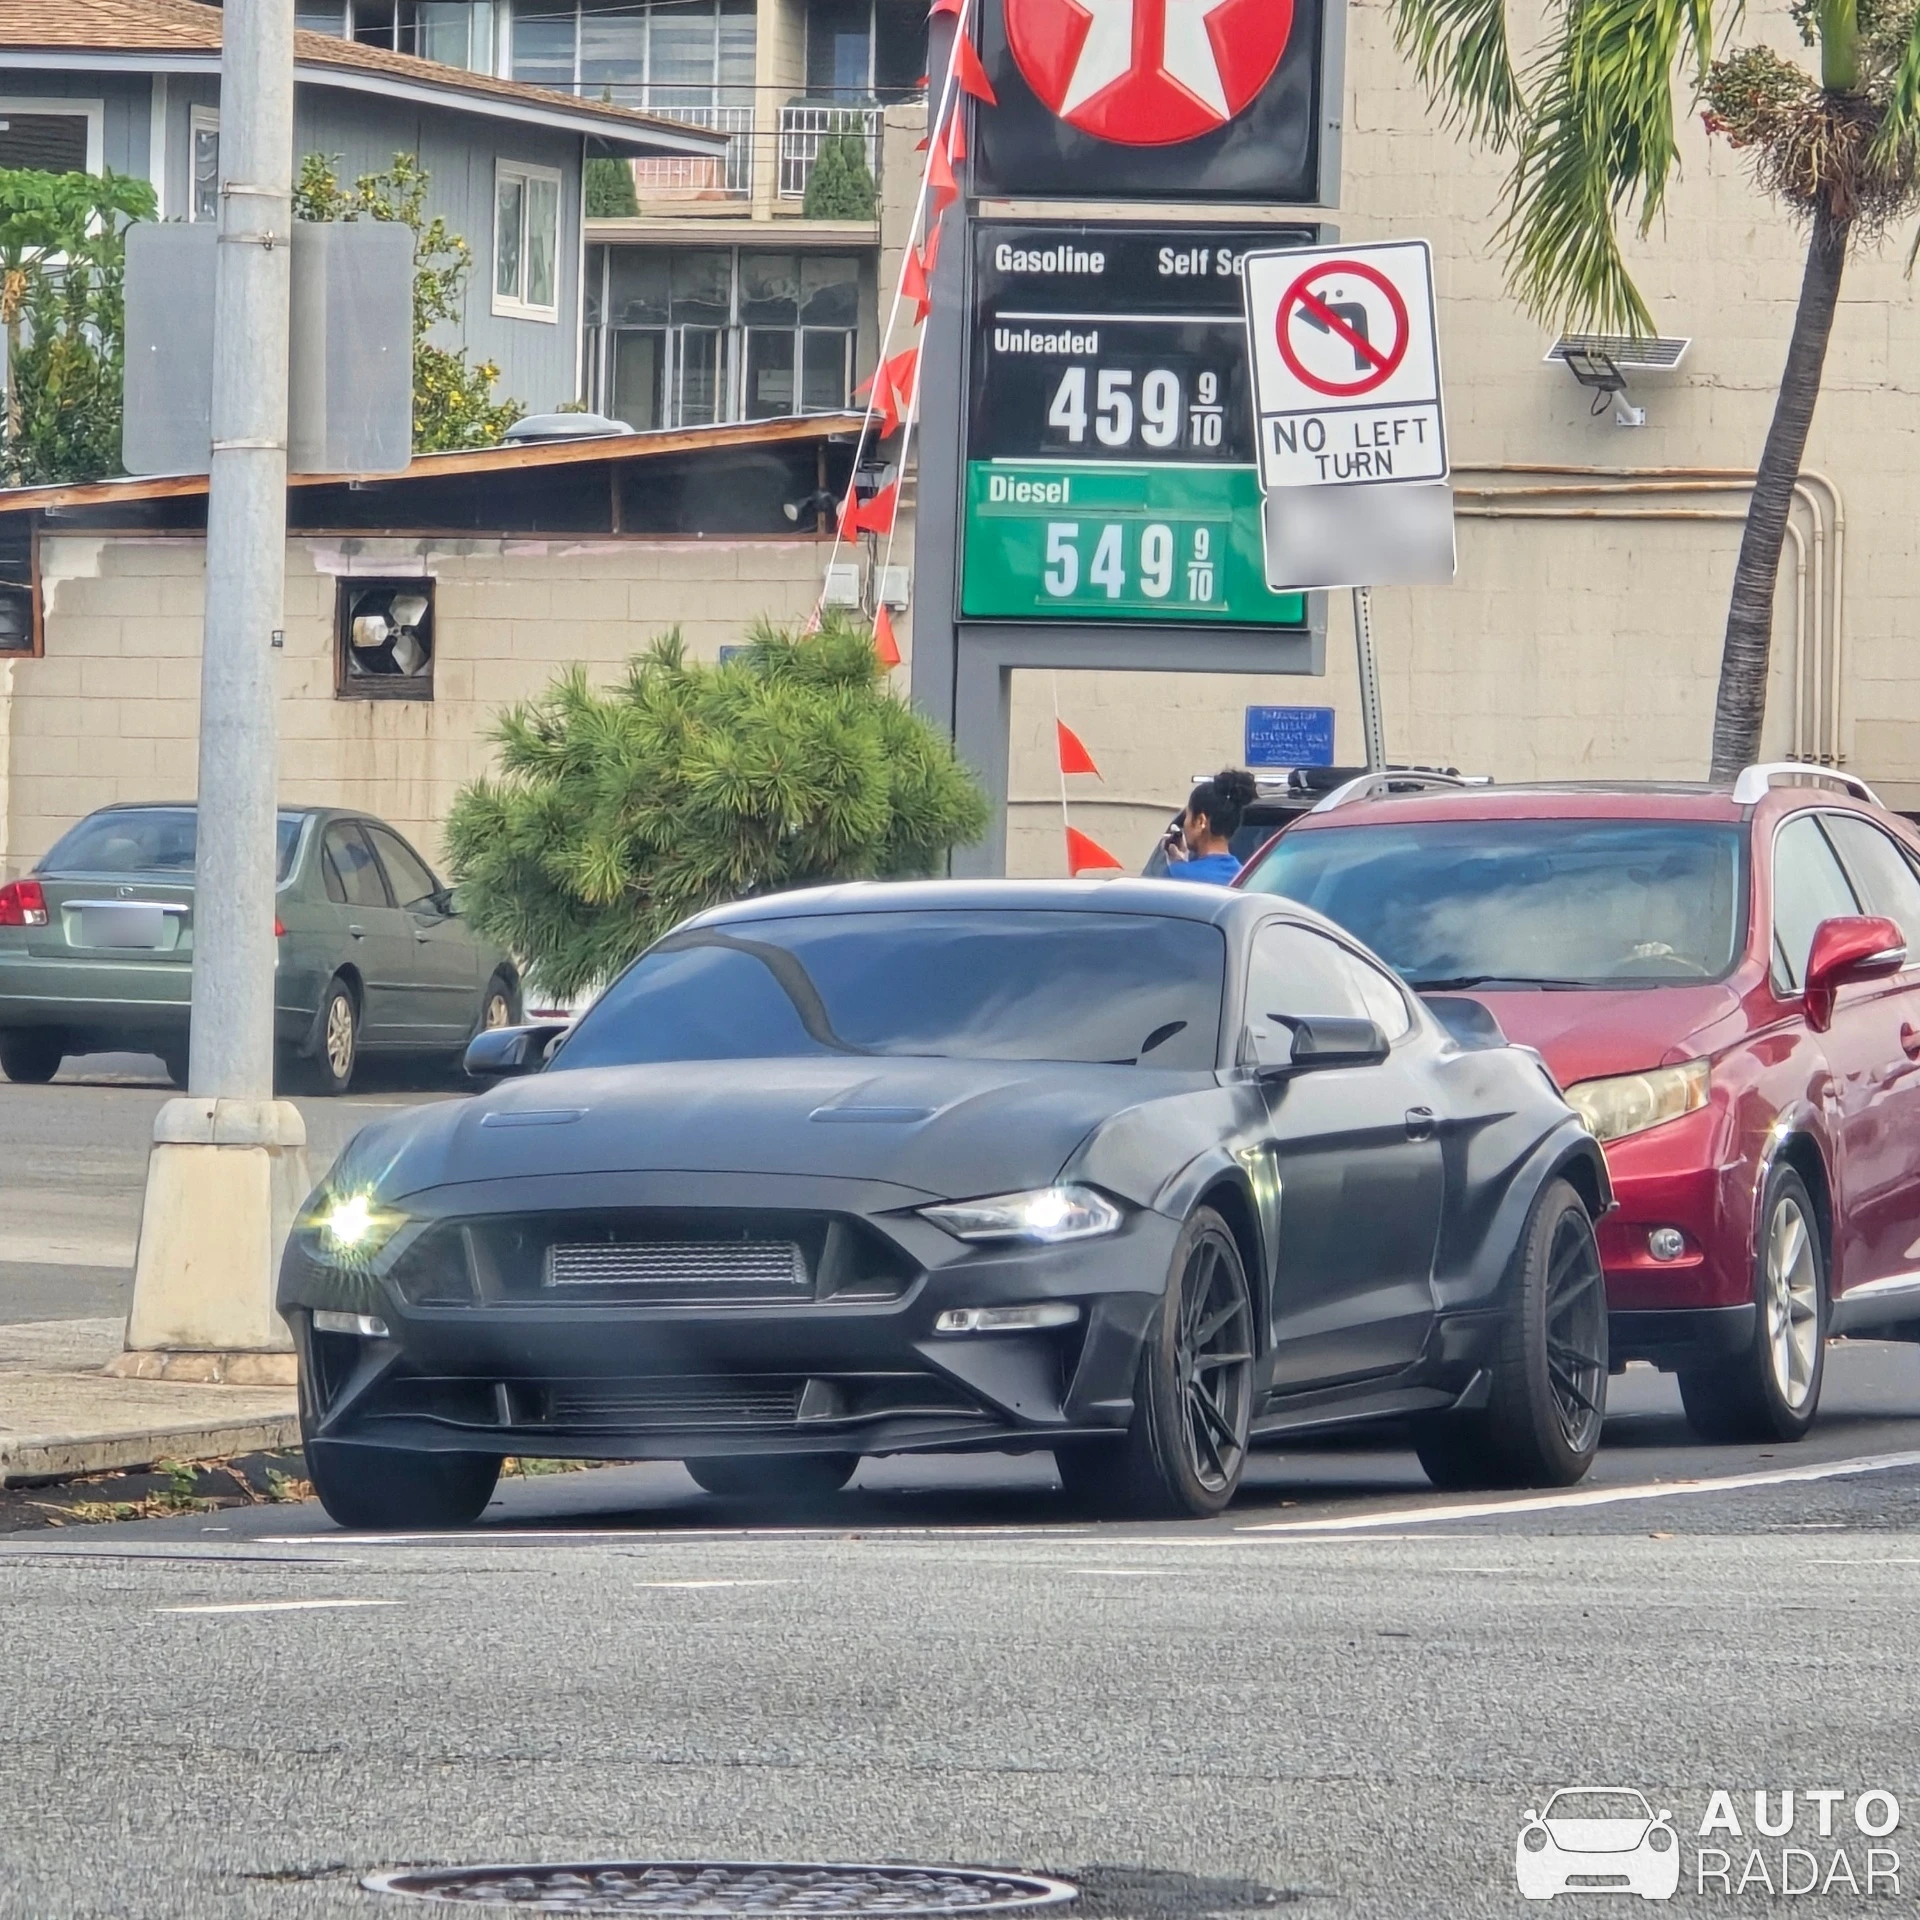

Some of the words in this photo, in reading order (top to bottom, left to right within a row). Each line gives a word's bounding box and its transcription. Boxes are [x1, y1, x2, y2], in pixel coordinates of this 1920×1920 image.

[995, 244, 1105, 273] Gasoline
[1158, 247, 1209, 275] Self
[1216, 248, 1243, 275] Se
[994, 328, 1098, 354] Unleaded
[1198, 371, 1217, 404] 9
[1048, 367, 1180, 446] 459
[1190, 413, 1222, 446] 10
[1273, 417, 1326, 455] NO
[1354, 418, 1428, 448] LEFT
[1314, 449, 1393, 480] TURN
[989, 475, 1070, 503] Diesel
[1044, 522, 1173, 598] 549
[1194, 527, 1210, 560] 9
[1187, 568, 1213, 601] 10
